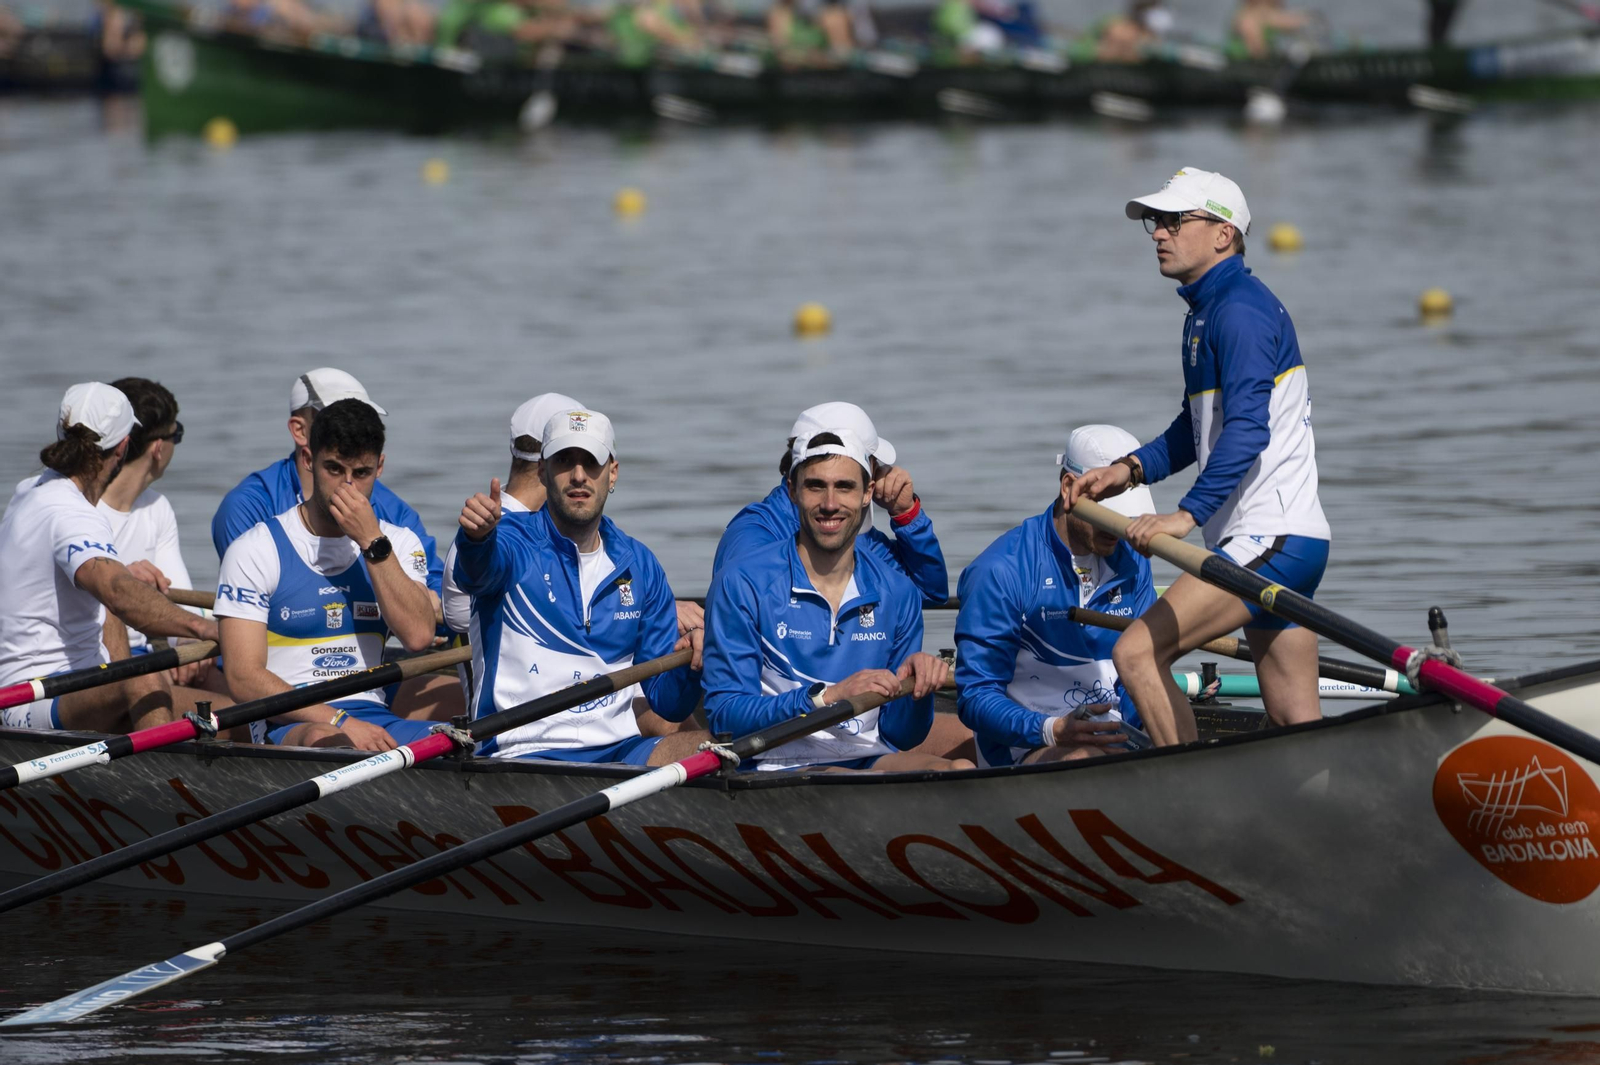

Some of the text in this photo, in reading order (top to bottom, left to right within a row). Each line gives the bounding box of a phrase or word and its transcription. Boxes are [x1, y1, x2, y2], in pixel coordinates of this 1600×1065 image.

[322, 655, 350, 667] Ford
[1319, 683, 1356, 691] erreteria
[49, 750, 86, 763] Ferreteria
[366, 753, 393, 767] SAR
[1502, 820, 1590, 840] club de rem
[1481, 838, 1599, 862] BADALONA
[492, 804, 1246, 925] BADALONA
